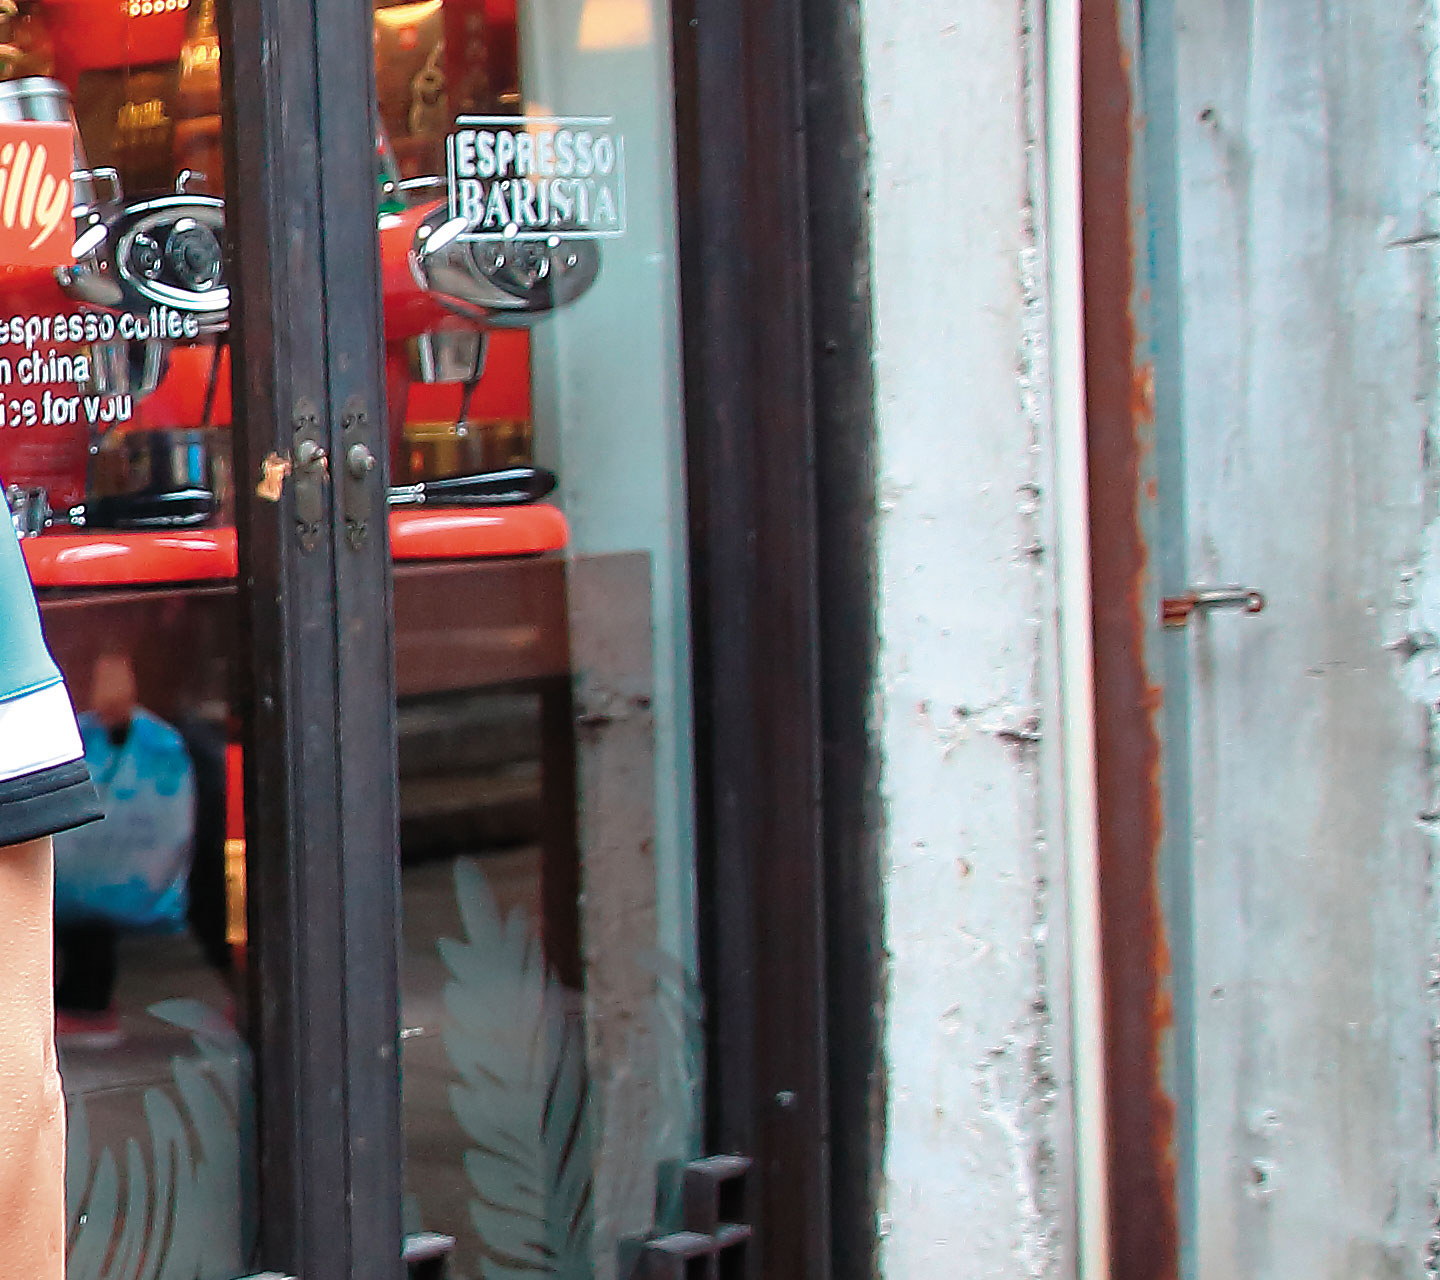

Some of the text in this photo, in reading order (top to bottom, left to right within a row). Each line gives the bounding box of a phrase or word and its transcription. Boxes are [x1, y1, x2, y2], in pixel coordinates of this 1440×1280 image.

[455, 130, 615, 177] ESPRESSO
[458, 178, 618, 227] BARISTA
[17, 347, 92, 386] china
